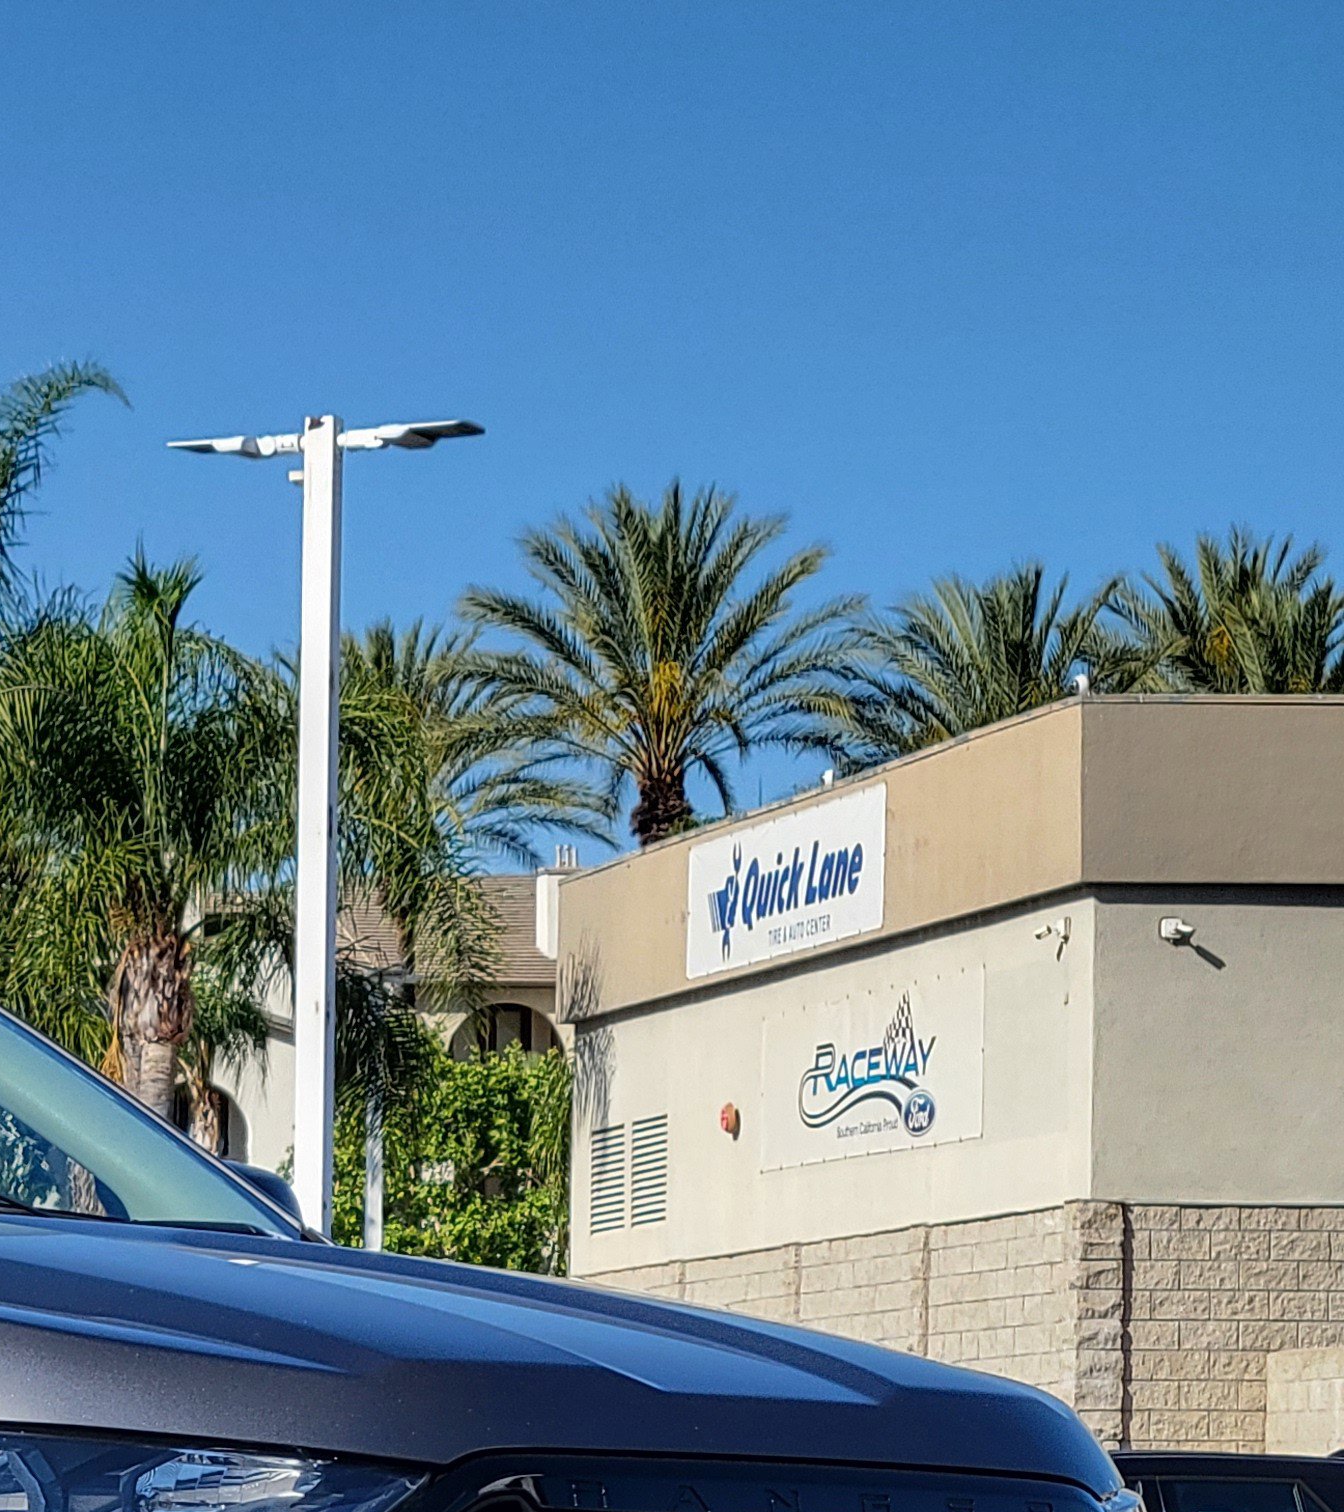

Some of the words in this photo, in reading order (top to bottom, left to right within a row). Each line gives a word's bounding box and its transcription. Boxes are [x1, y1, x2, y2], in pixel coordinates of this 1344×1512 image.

[742, 846, 804, 931] Quick
[805, 840, 863, 906] Lane
[806, 914, 831, 936] CENTER
[812, 1035, 937, 1096] RACEWAY
[908, 1096, 931, 1129] Ford
